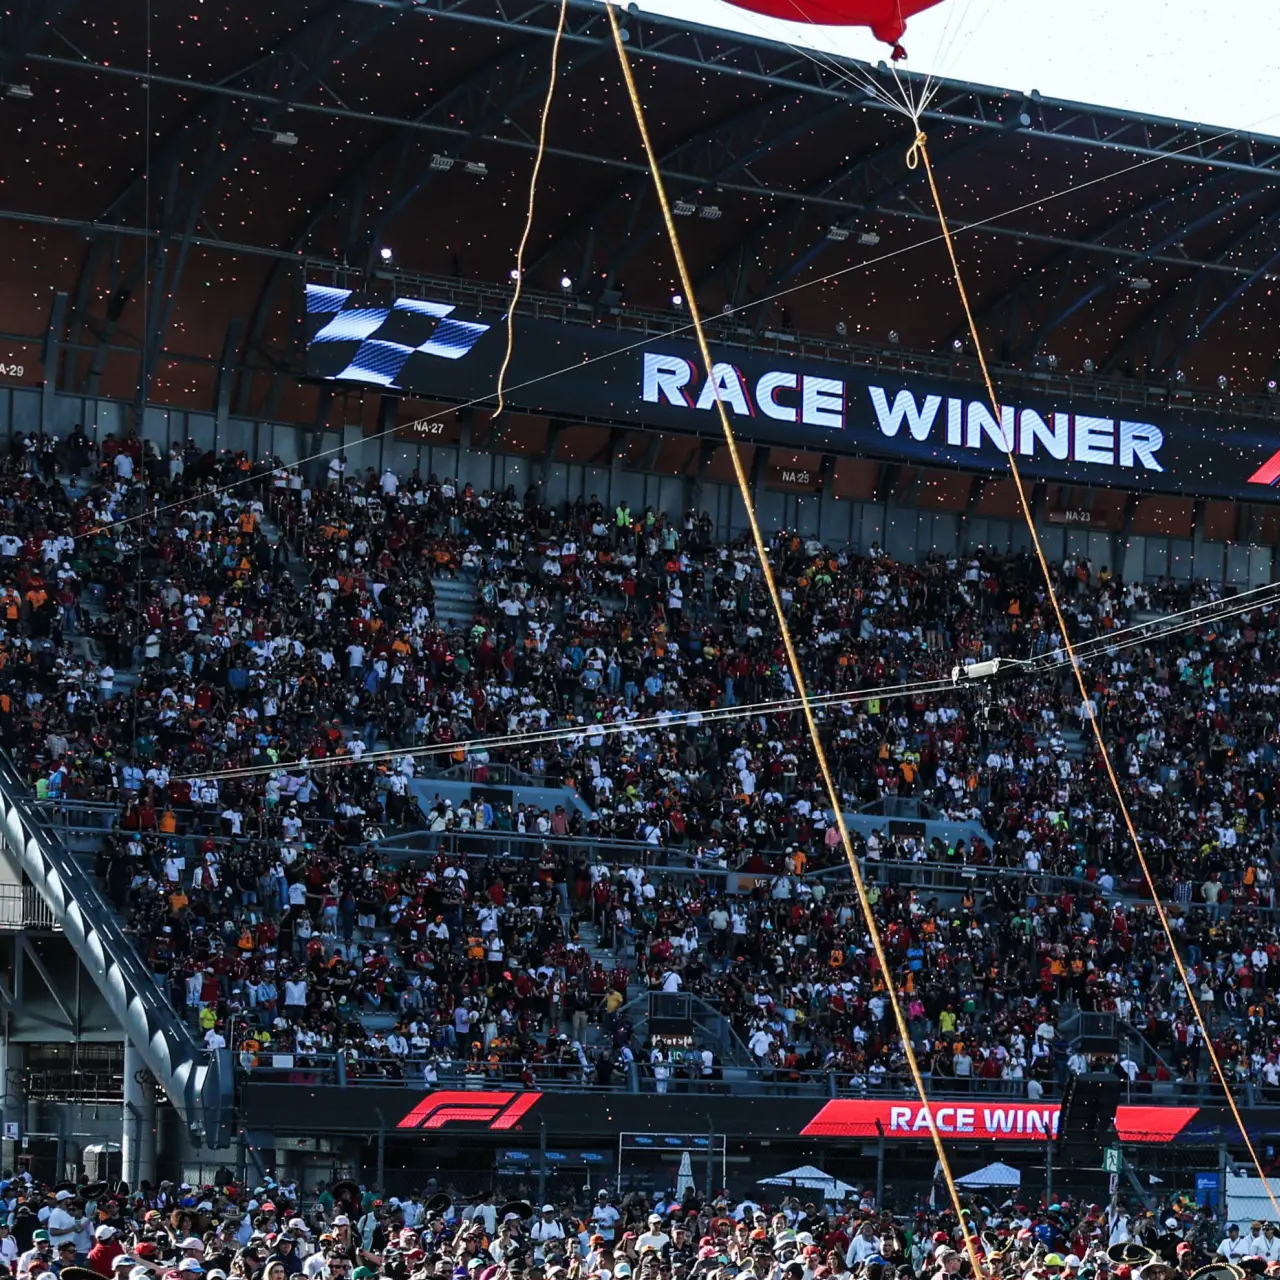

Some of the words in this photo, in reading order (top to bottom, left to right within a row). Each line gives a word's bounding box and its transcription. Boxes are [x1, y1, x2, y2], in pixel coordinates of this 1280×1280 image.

[643, 352, 845, 429] RACE
[868, 386, 1165, 472] WINNER
[890, 1105, 974, 1132] RACE
